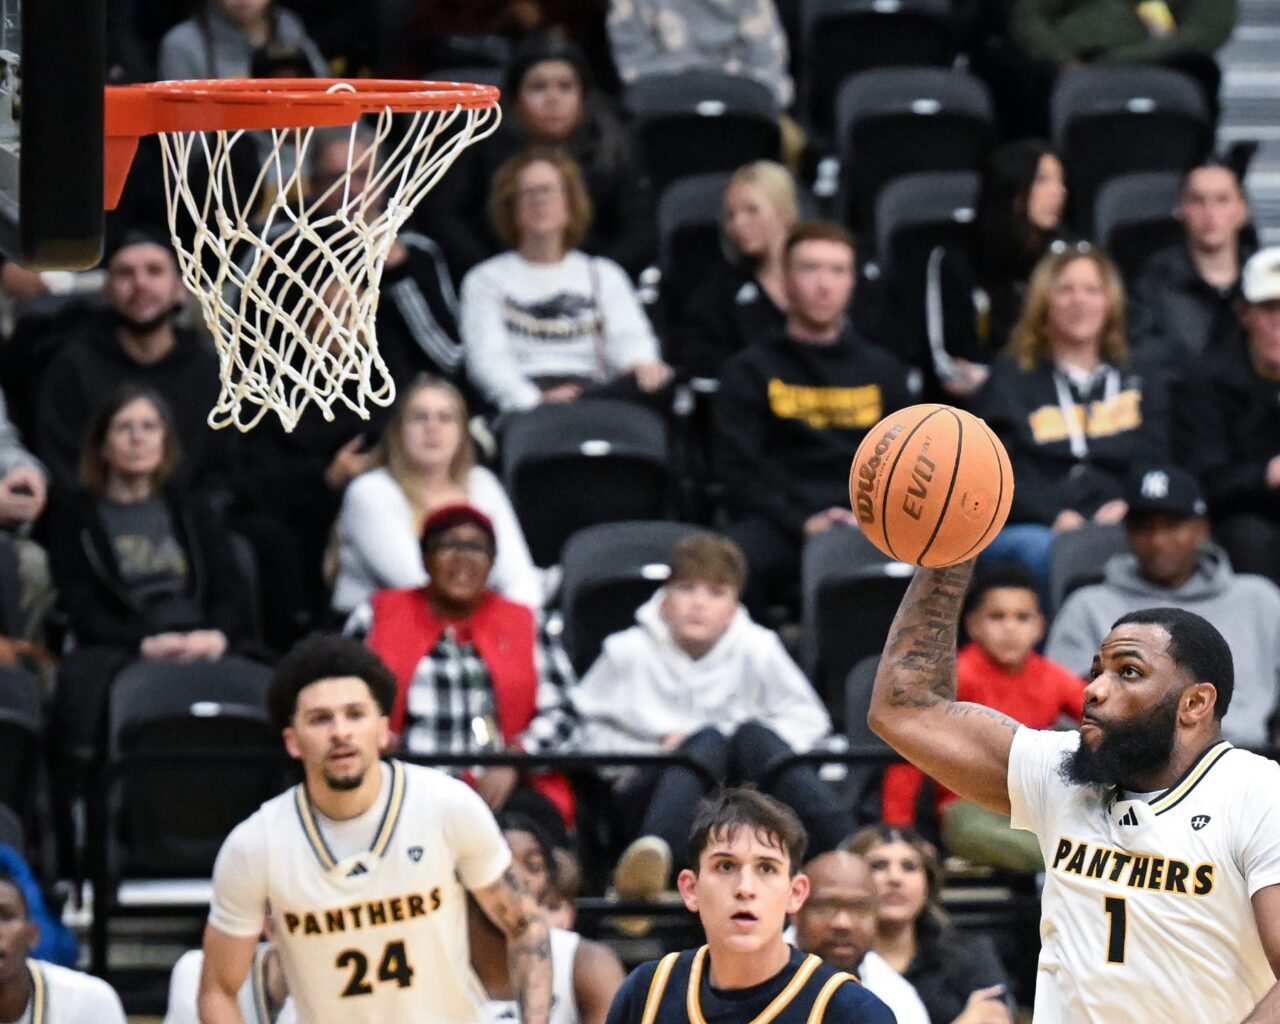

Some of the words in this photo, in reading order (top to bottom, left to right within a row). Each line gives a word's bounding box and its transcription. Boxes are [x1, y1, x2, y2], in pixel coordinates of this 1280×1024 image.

[857, 423, 905, 524] Wilson
[1051, 836, 1216, 897] PANTHERS
[283, 886, 443, 936] PANTHERS
[1103, 894, 1127, 965] 1
[334, 938, 415, 998] 24
